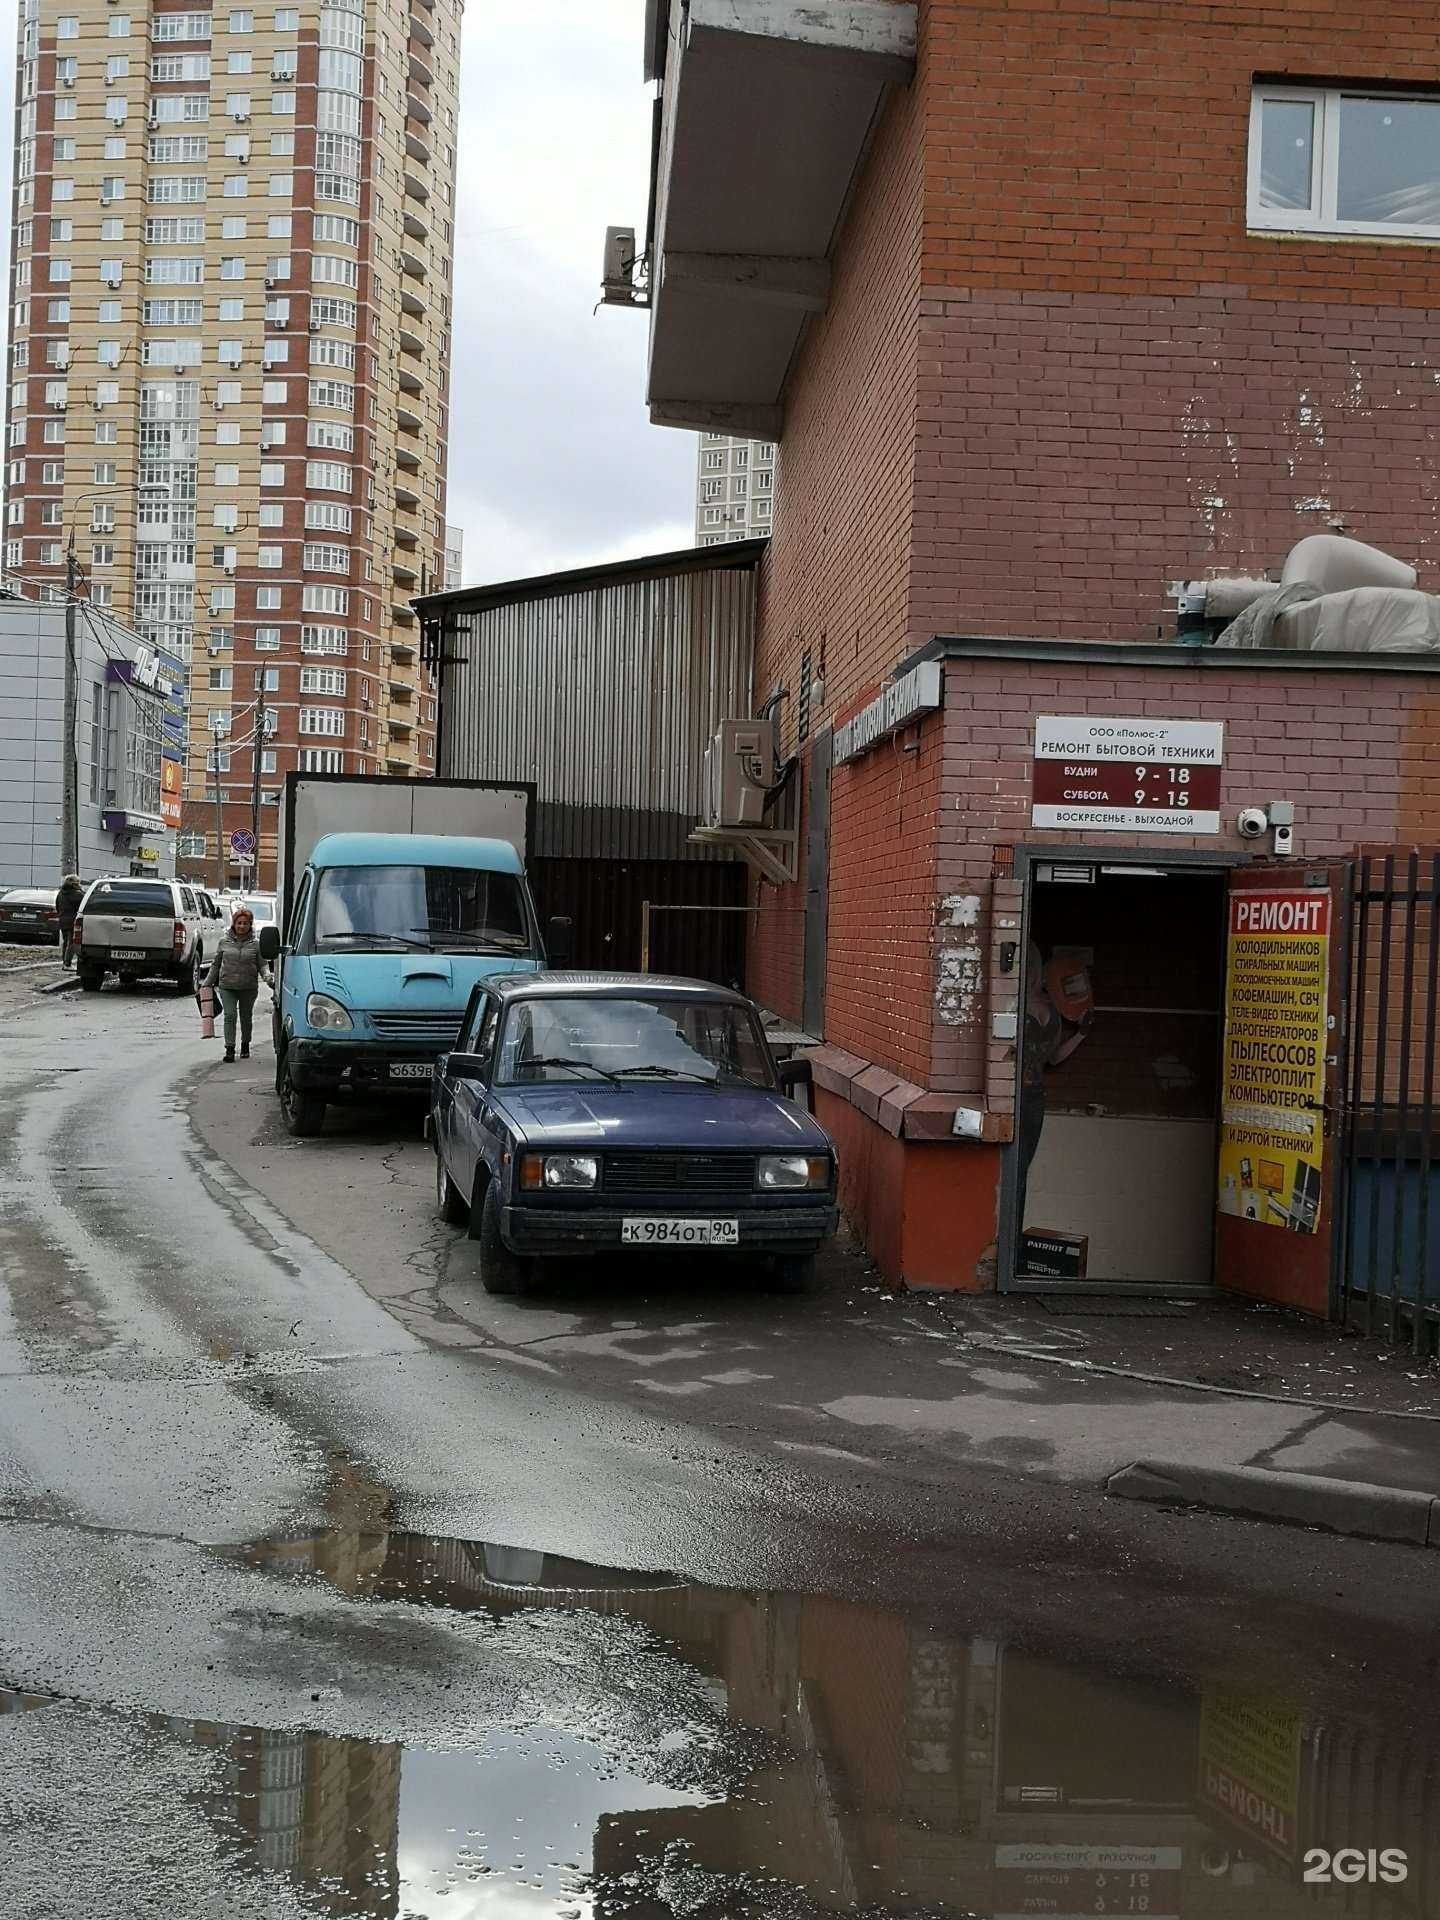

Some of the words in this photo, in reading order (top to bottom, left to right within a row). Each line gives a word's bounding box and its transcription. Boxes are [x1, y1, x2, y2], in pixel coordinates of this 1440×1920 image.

[1089, 727, 1115, 737] ООО
[1041, 742, 1091, 754] РЕМОНТ
[1096, 744, 1155, 757] БЫТОВОЙ
[1161, 746, 1215, 759] ТЕХНИКИ
[1064, 766, 1098, 777] БУДНИ
[1135, 766, 1146, 782] 9
[1168, 768, 1190, 784] 18
[1063, 789, 1109, 801] СУББОТА
[1134, 790, 1146, 805] 9
[1167, 791, 1189, 807] 15
[1056, 812, 1126, 823] ВОСКРЕСЕНЬЕ
[1135, 815, 1194, 826] ВЫХОДНОЙ
[1236, 900, 1323, 931] РЕМОНТ
[1234, 940, 1320, 957] ХОЛОДИЛЬНИКОВ
[1234, 958, 1285, 971] СТИРАЛЬНЫХ
[1286, 960, 1320, 973] МАШИН
[1233, 974, 1291, 986] ПОСУДОМОЕЧНЫХ
[1292, 977, 1320, 987] МАШИН
[1232, 989, 1298, 1006] КОФЕМАШИН,
[1299, 991, 1319, 1006] СВЧ
[1232, 1006, 1279, 1021] ТЕЛЕ-ВИДЕО
[1280, 1009, 1319, 1024] ТЕХНИКИ
[1230, 1023, 1319, 1042] ПАРОГЕНЕРАТОРОВ
[1230, 1041, 1316, 1067] ПЫЛЕСОСОВ
[393, 1065, 433, 1077] О639В
[1230, 1063, 1316, 1089] ЭЛЕКТРОПЛИТ
[1229, 1085, 1315, 1109] КОМПЬЮТЕРОВ
[1229, 1128, 1236, 1141] И
[1236, 1130, 1270, 1146] ДРУГОЙ
[1271, 1136, 1314, 1154] ТЕХНИКИ
[713, 1222, 732, 1236] 90
[1027, 1240, 1065, 1253] PATRIOT
